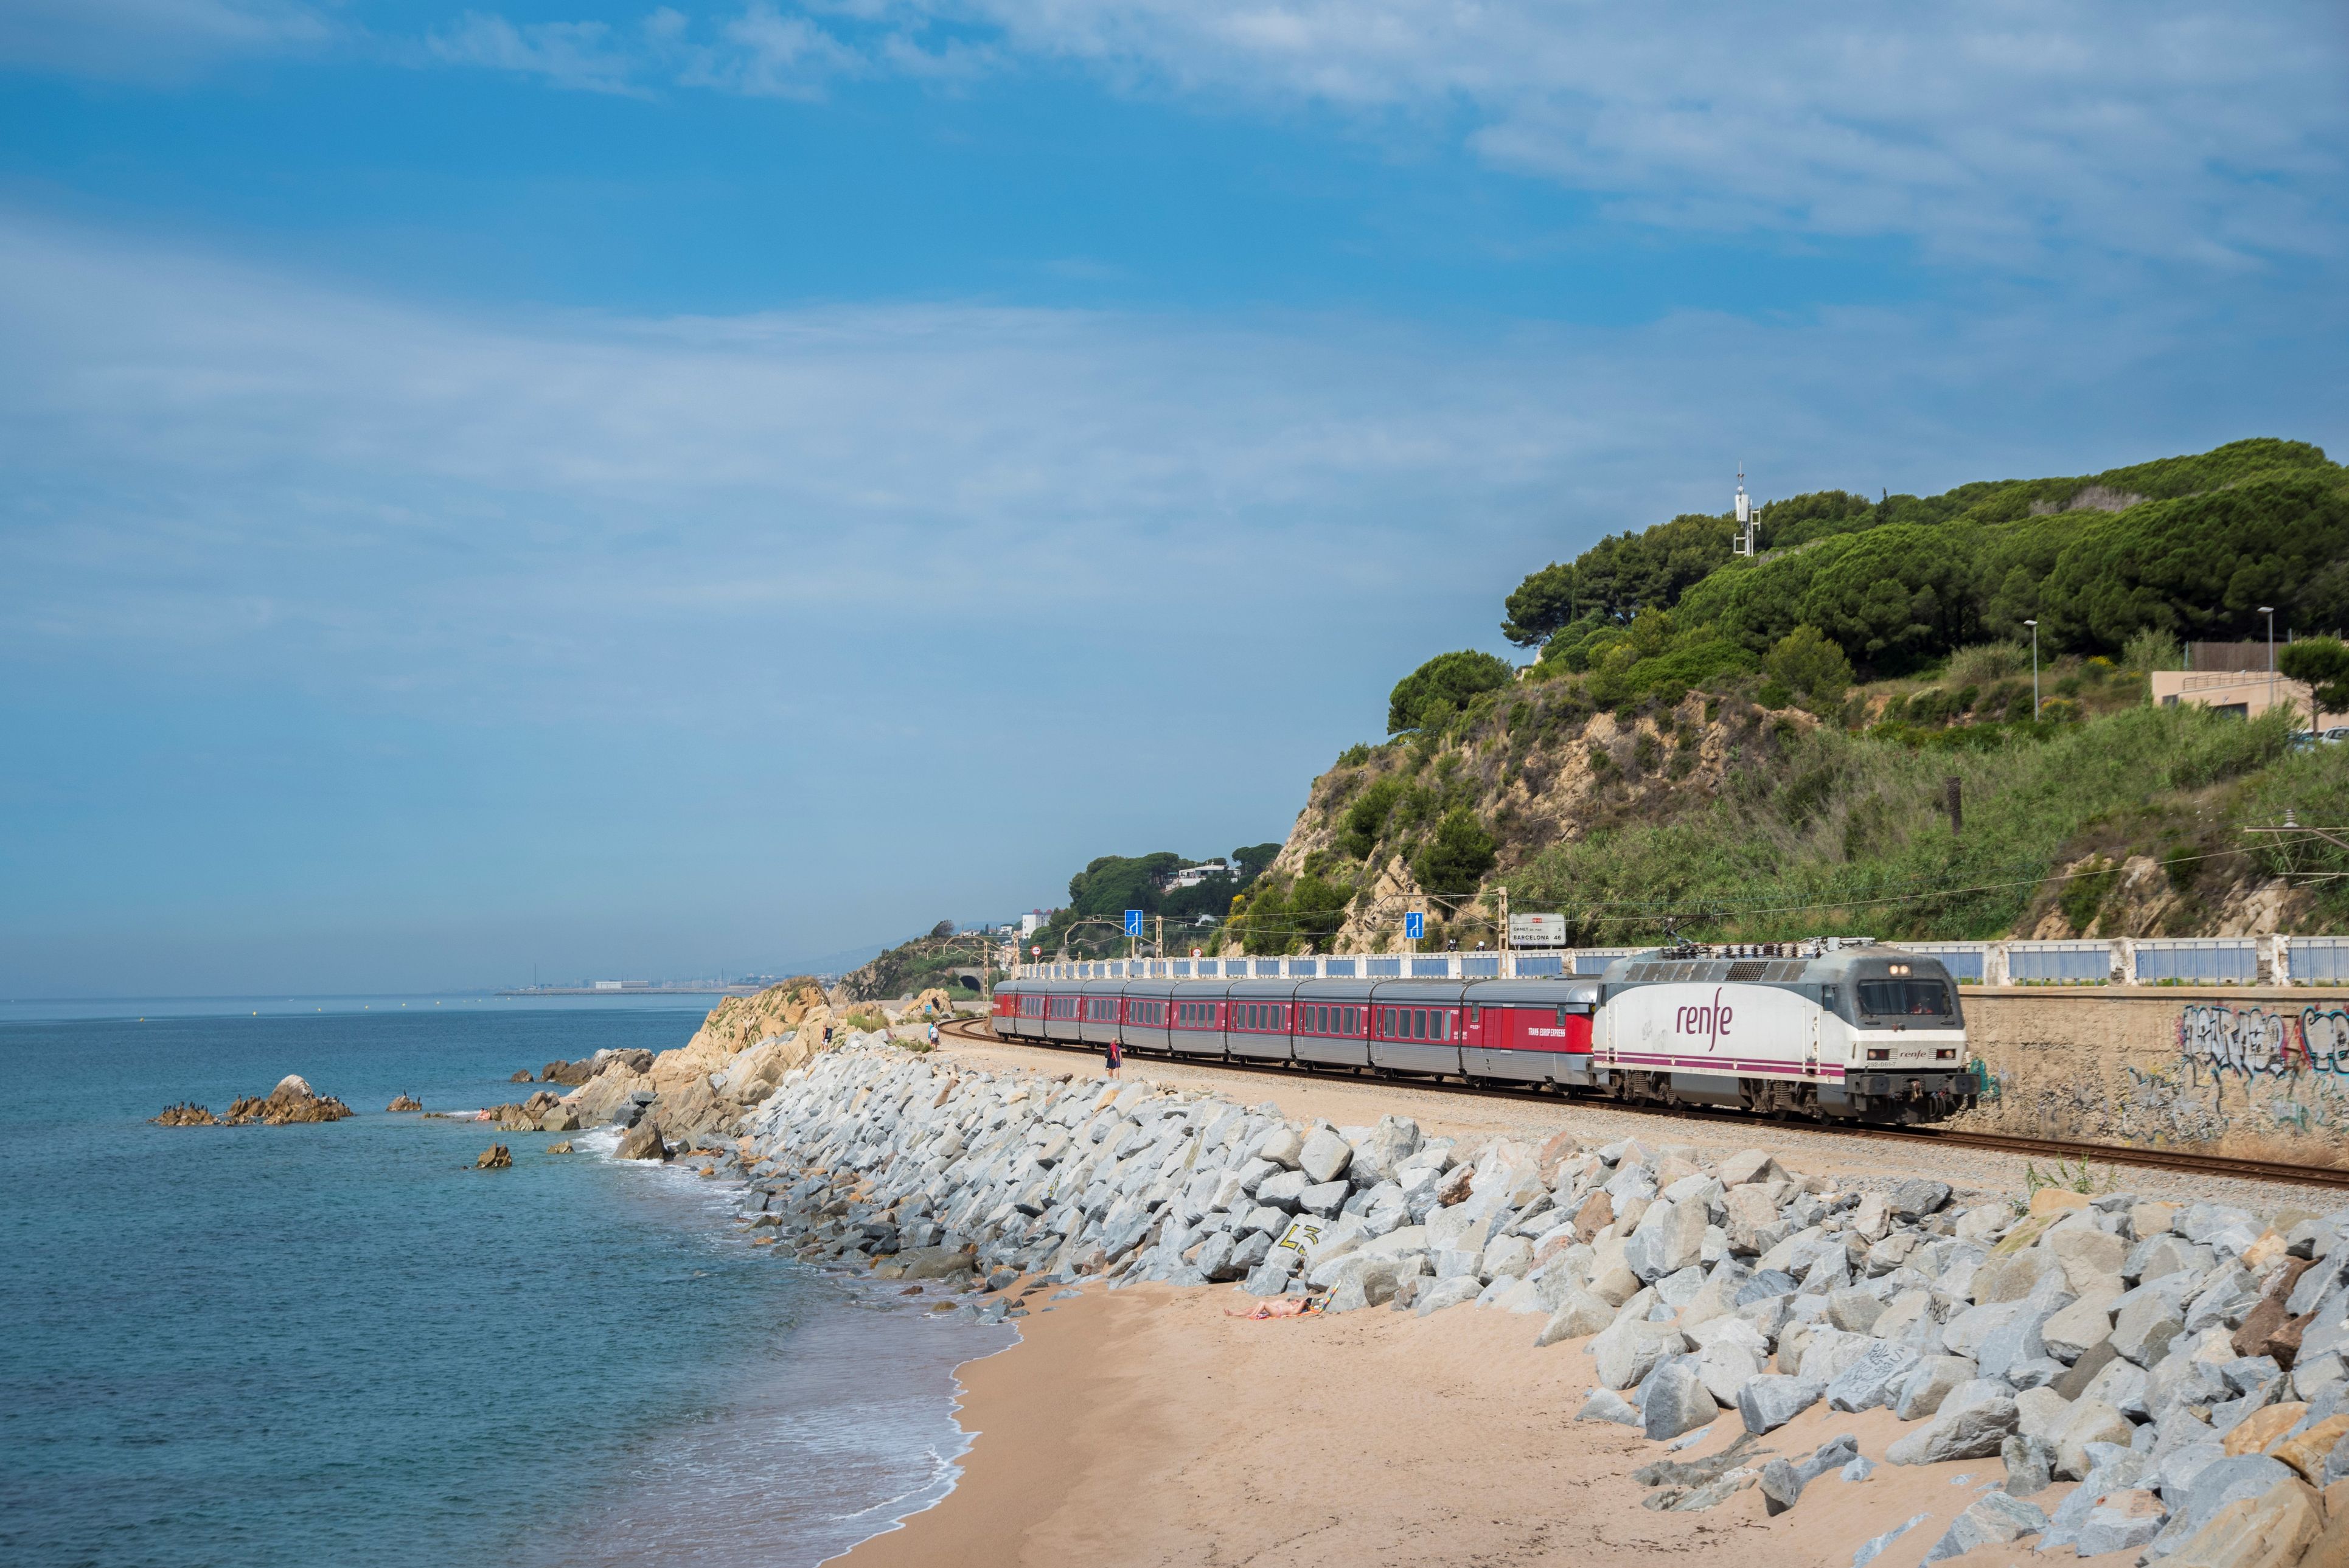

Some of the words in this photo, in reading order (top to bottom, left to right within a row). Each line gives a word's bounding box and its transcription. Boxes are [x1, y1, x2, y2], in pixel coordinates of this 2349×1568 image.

[1676, 987, 1733, 1052] renfe
[1528, 1027, 1539, 1036] TRANS
[1539, 1028, 1550, 1036] EUROP
[1550, 1029, 1565, 1037] EXPRESS
[1900, 1049, 1927, 1060] renfe
